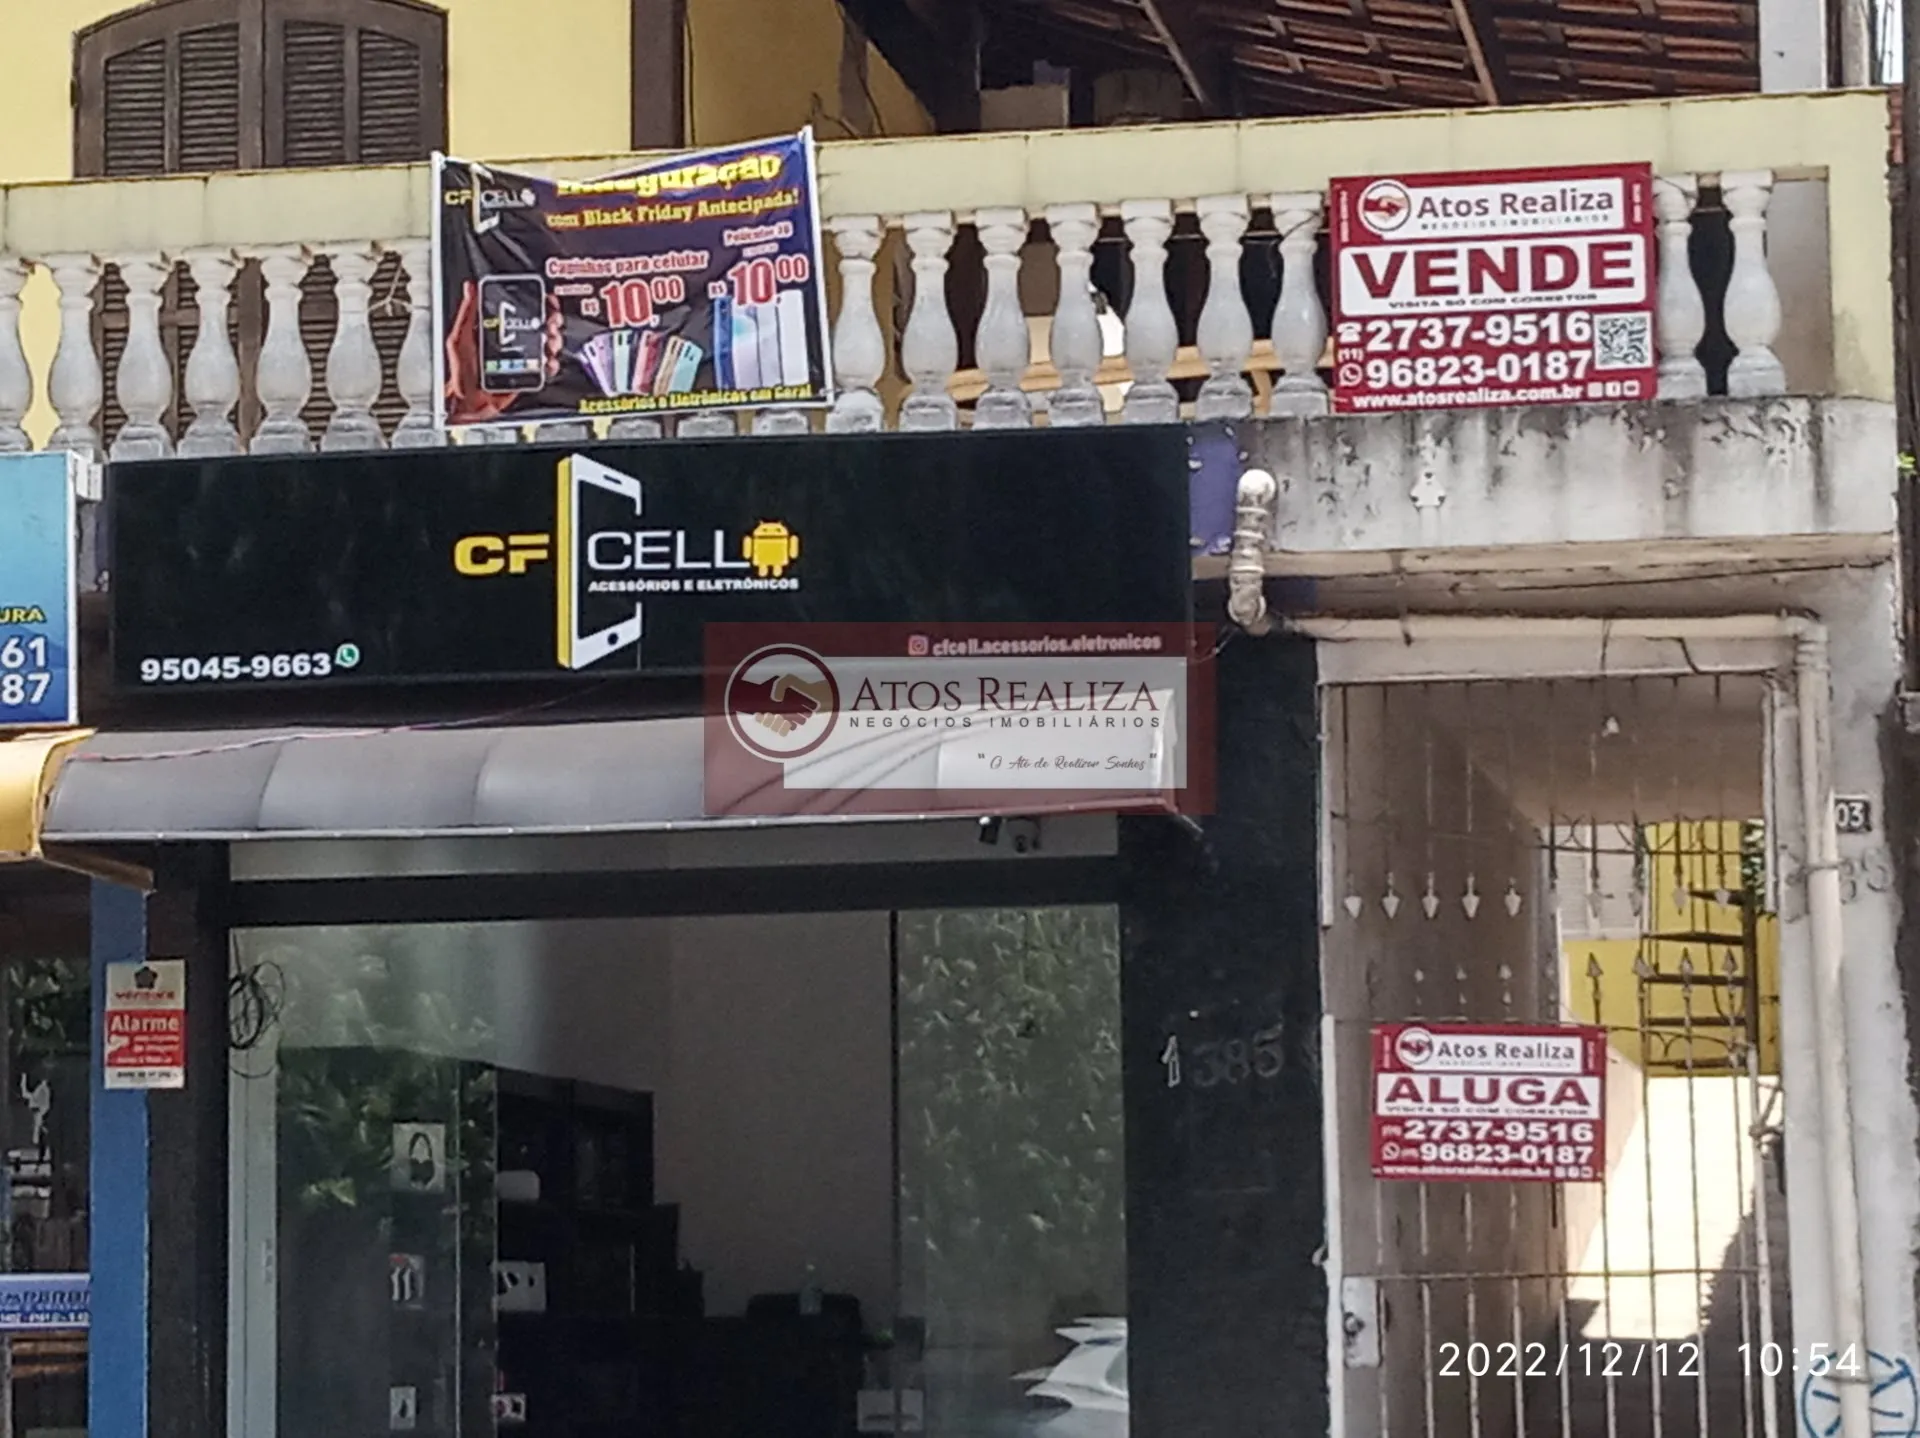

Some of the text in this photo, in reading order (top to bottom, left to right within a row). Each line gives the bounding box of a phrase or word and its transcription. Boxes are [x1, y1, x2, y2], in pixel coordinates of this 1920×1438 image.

[584, 208, 634, 225] Black
[638, 204, 692, 222] Friday
[697, 188, 799, 216] Antecipada!
[1417, 196, 1489, 219] Atos
[1500, 188, 1614, 216] Realiza
[616, 258, 650, 274] para
[653, 252, 706, 269] celular
[1352, 241, 1635, 299] VENDE
[1366, 311, 1592, 352] 2737-9516
[1366, 350, 1593, 389] 96823-0187
[774, 384, 812, 399] Geral
[1353, 384, 1583, 409] www.atosrealiza.com.br
[453, 529, 751, 577] CF CELL
[588, 577, 799, 592] ACESSÓRIOS E ELETRÔNICOS
[0, 636, 47, 669] 61
[140, 652, 332, 682] 95045-9663
[1, 672, 51, 706] 87
[111, 1014, 180, 1032] Alarme
[1438, 1041, 1488, 1059] Atos
[1495, 1041, 1575, 1061] Realiza
[1385, 1077, 1592, 1107] ALUGA
[1403, 1119, 1594, 1143] 2737-9516
[1419, 1142, 1594, 1165] 96823-0187
